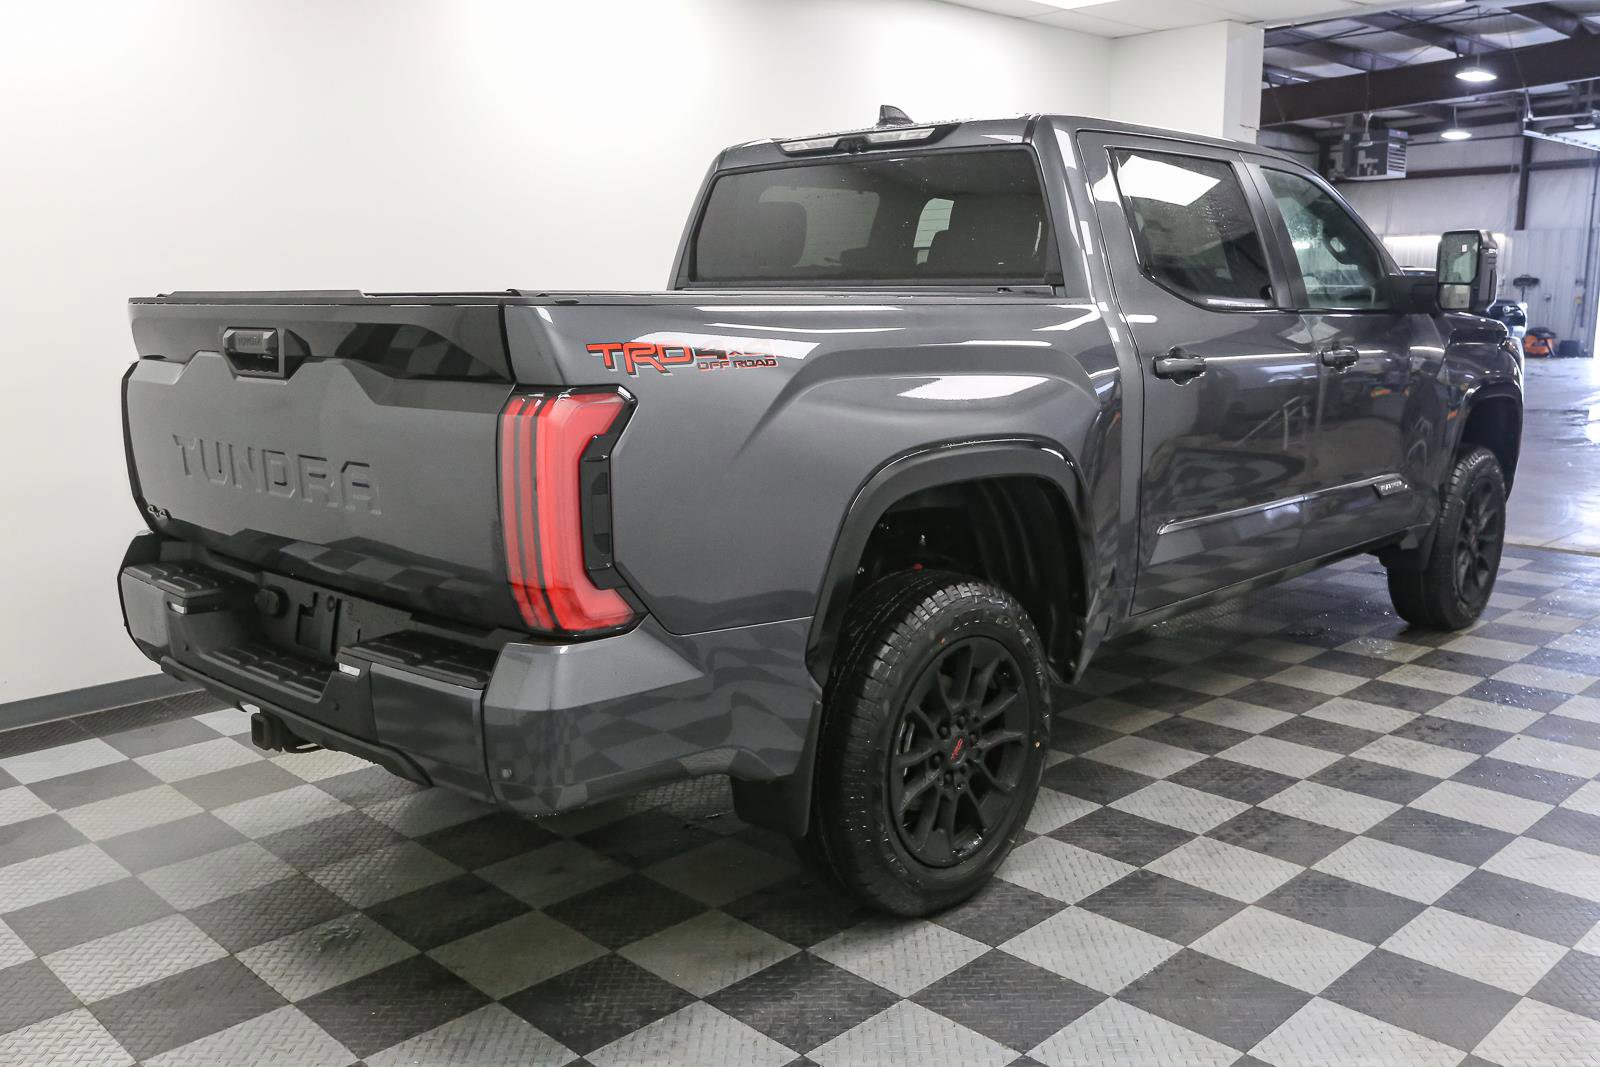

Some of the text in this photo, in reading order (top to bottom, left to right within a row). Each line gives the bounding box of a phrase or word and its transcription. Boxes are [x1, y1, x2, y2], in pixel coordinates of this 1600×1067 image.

[585, 341, 695, 378] TRD
[696, 356, 779, 372] OFF ROAD
[171, 433, 383, 516] TUNDRA
